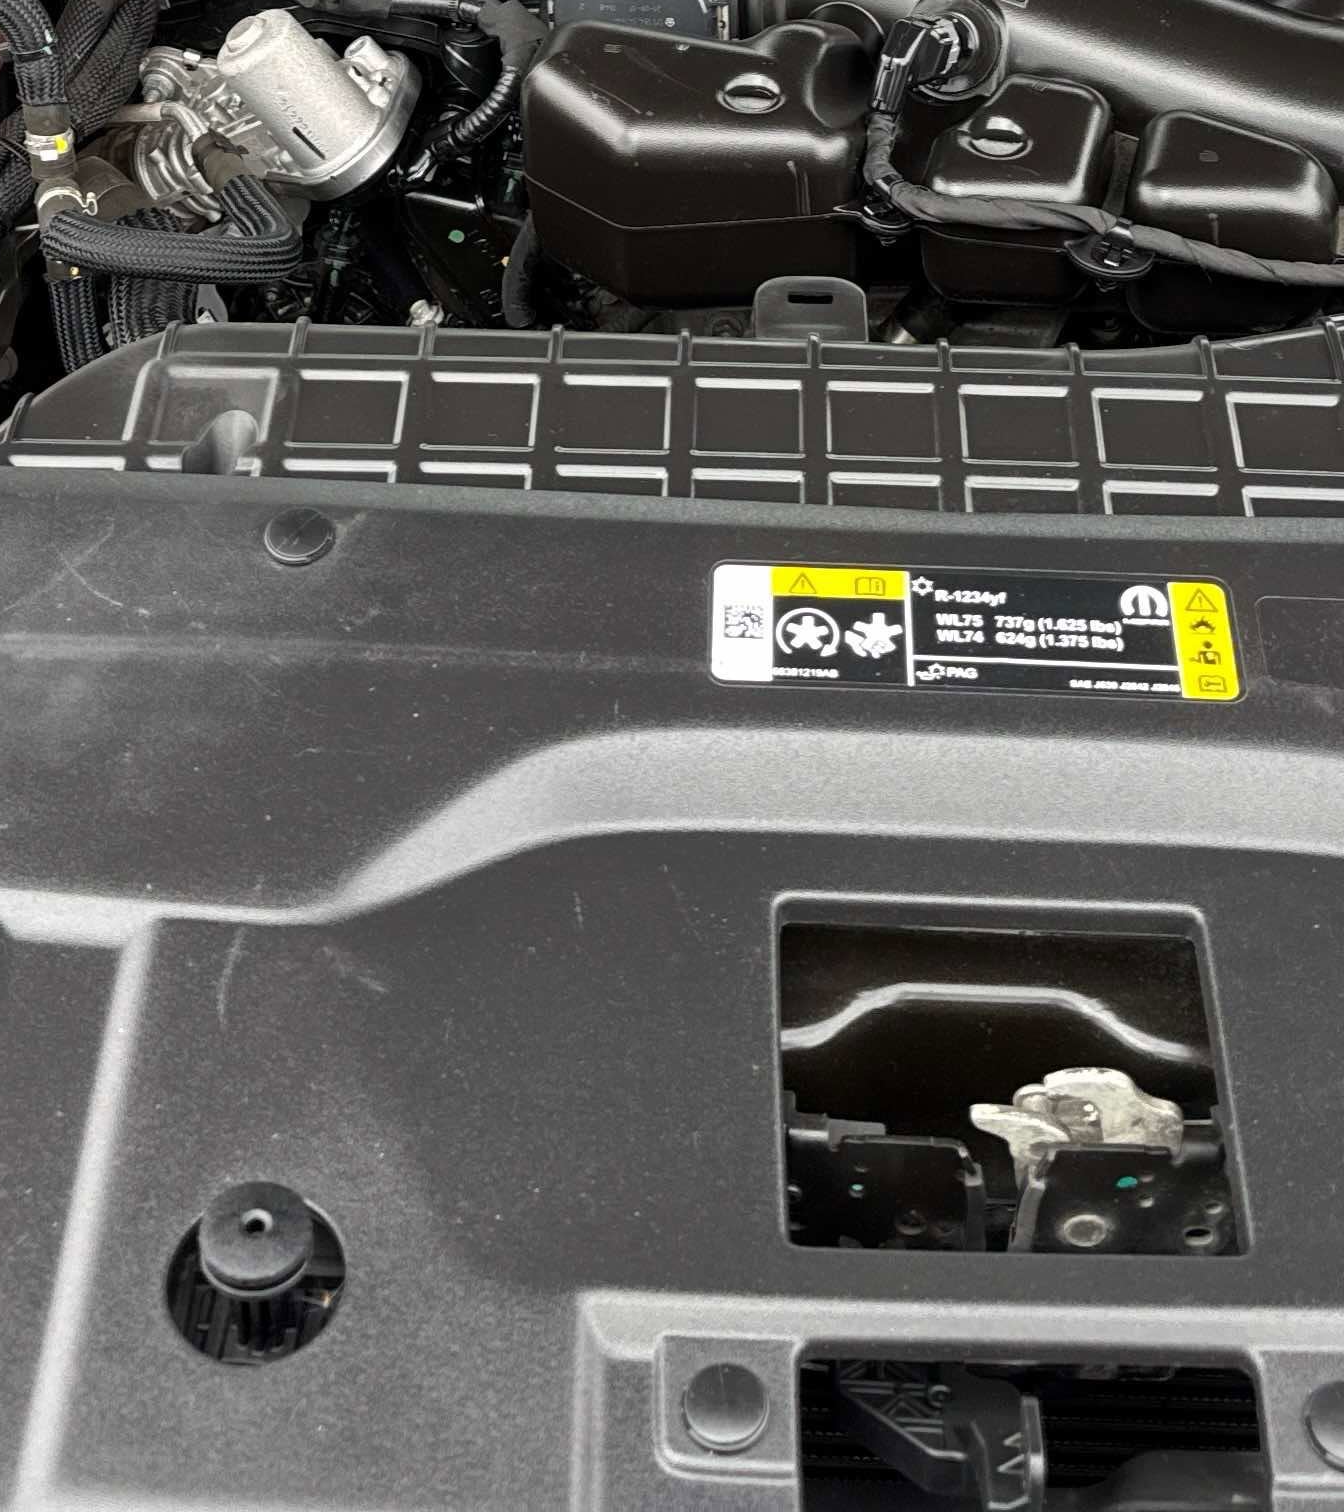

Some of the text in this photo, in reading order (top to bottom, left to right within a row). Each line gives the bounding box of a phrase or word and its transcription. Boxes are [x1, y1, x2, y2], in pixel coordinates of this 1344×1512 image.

[934, 589, 1007, 607] R-1234yf
[935, 613, 984, 628] WL75
[994, 615, 1036, 632] 737g
[1089, 620, 1122, 636] lbs)
[936, 629, 1125, 652] WL74 624g (1.375 lbs)
[946, 666, 979, 680] PAG
